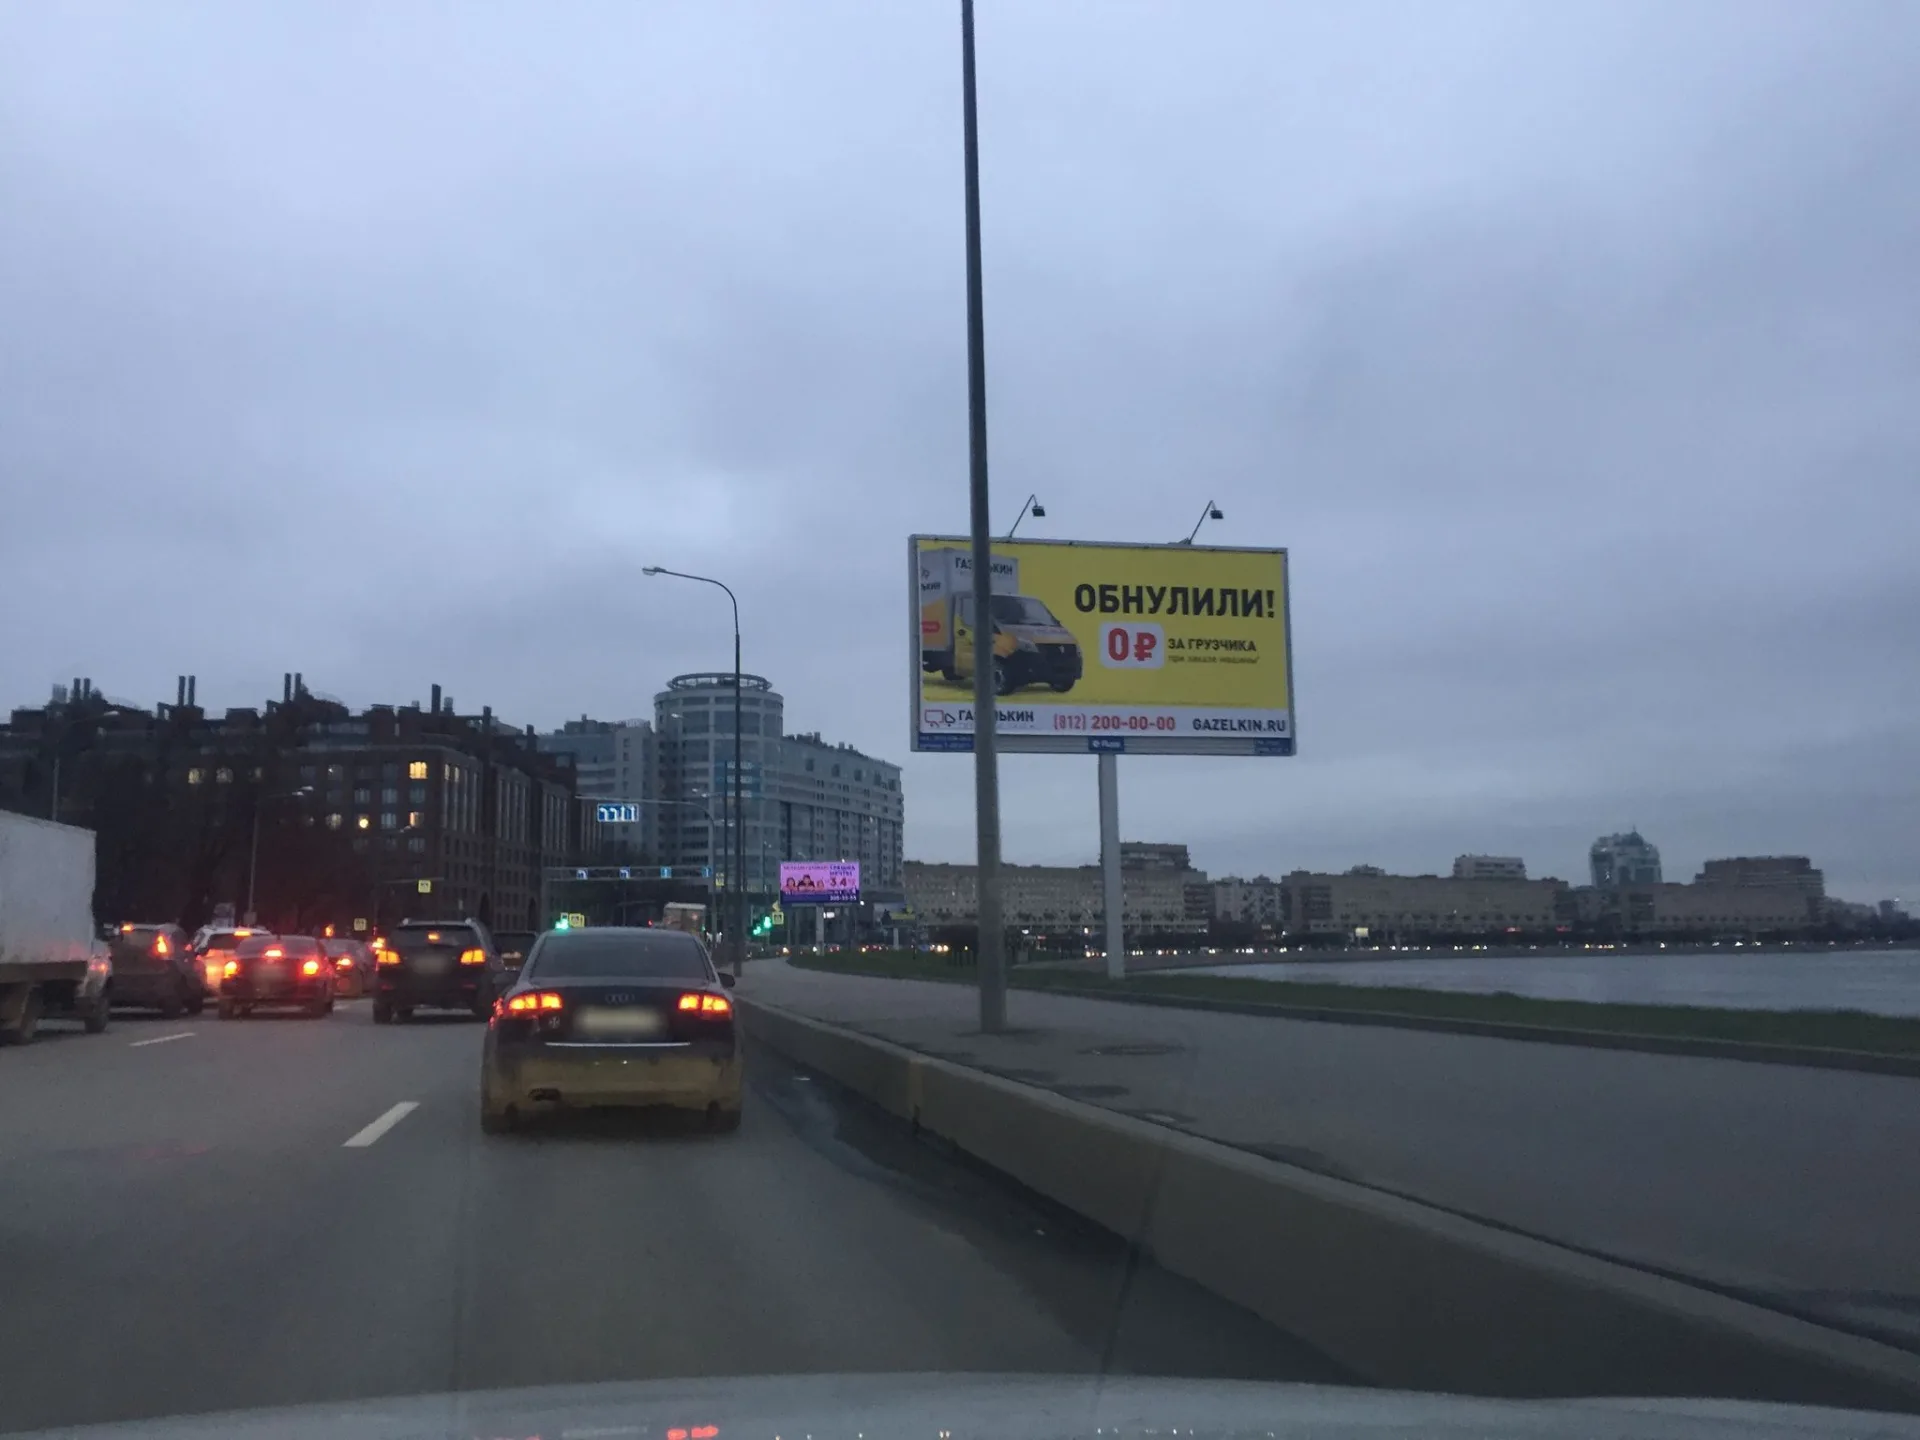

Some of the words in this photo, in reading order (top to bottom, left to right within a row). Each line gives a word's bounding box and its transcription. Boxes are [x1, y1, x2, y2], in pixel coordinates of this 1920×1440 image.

[955, 557, 1013, 575] ГАЗКИН
[1074, 583, 1275, 618] ОБНУЛИЛИ!
[1168, 638, 1185, 650] ЗА
[1187, 638, 1257, 652] ГРУЗЧИКА
[958, 709, 1035, 723] ГАЬКИН
[1053, 713, 1087, 731] (812)
[1091, 714, 1176, 731] 200-00-00
[1192, 717, 1286, 732] GAZELKIN.RU
